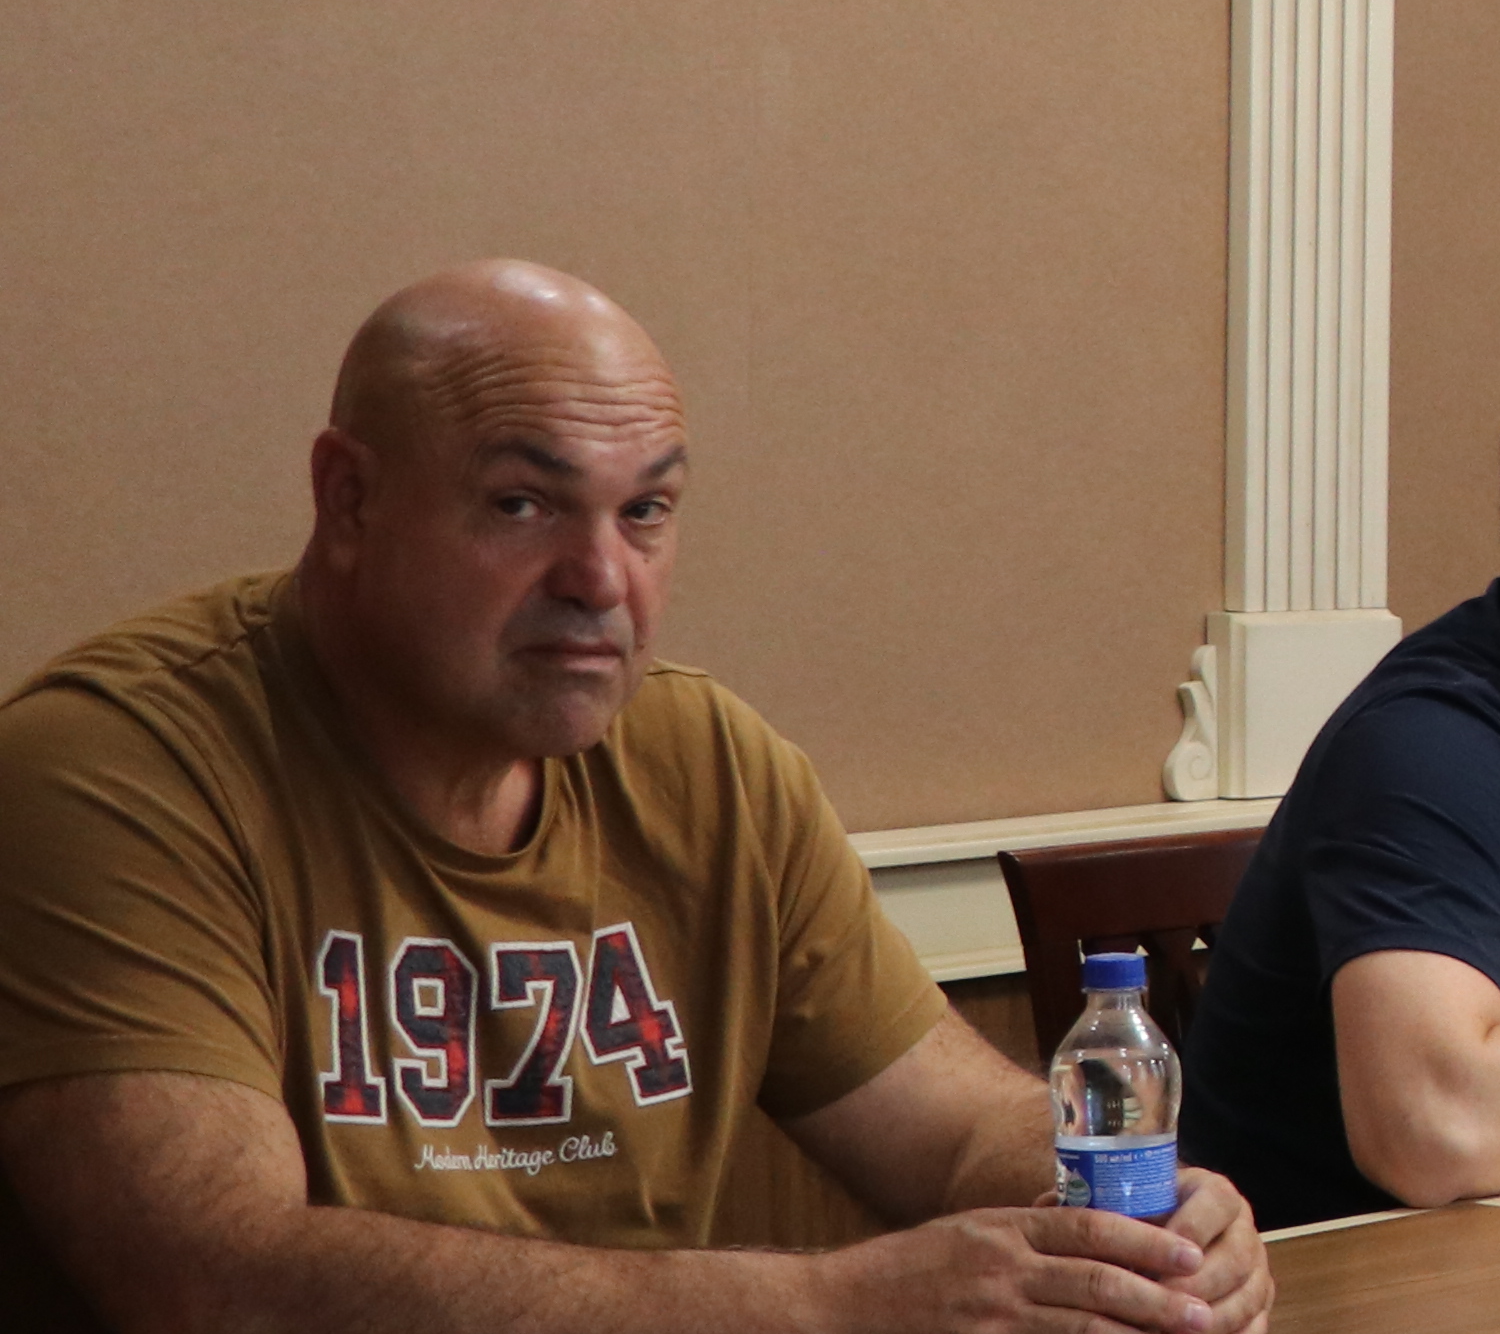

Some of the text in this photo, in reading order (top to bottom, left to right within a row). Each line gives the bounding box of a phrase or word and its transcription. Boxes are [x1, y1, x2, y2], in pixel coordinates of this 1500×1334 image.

[316, 921, 694, 1128] 1974
[474, 1144, 555, 1176] Heritage
[558, 1130, 619, 1163] Club
